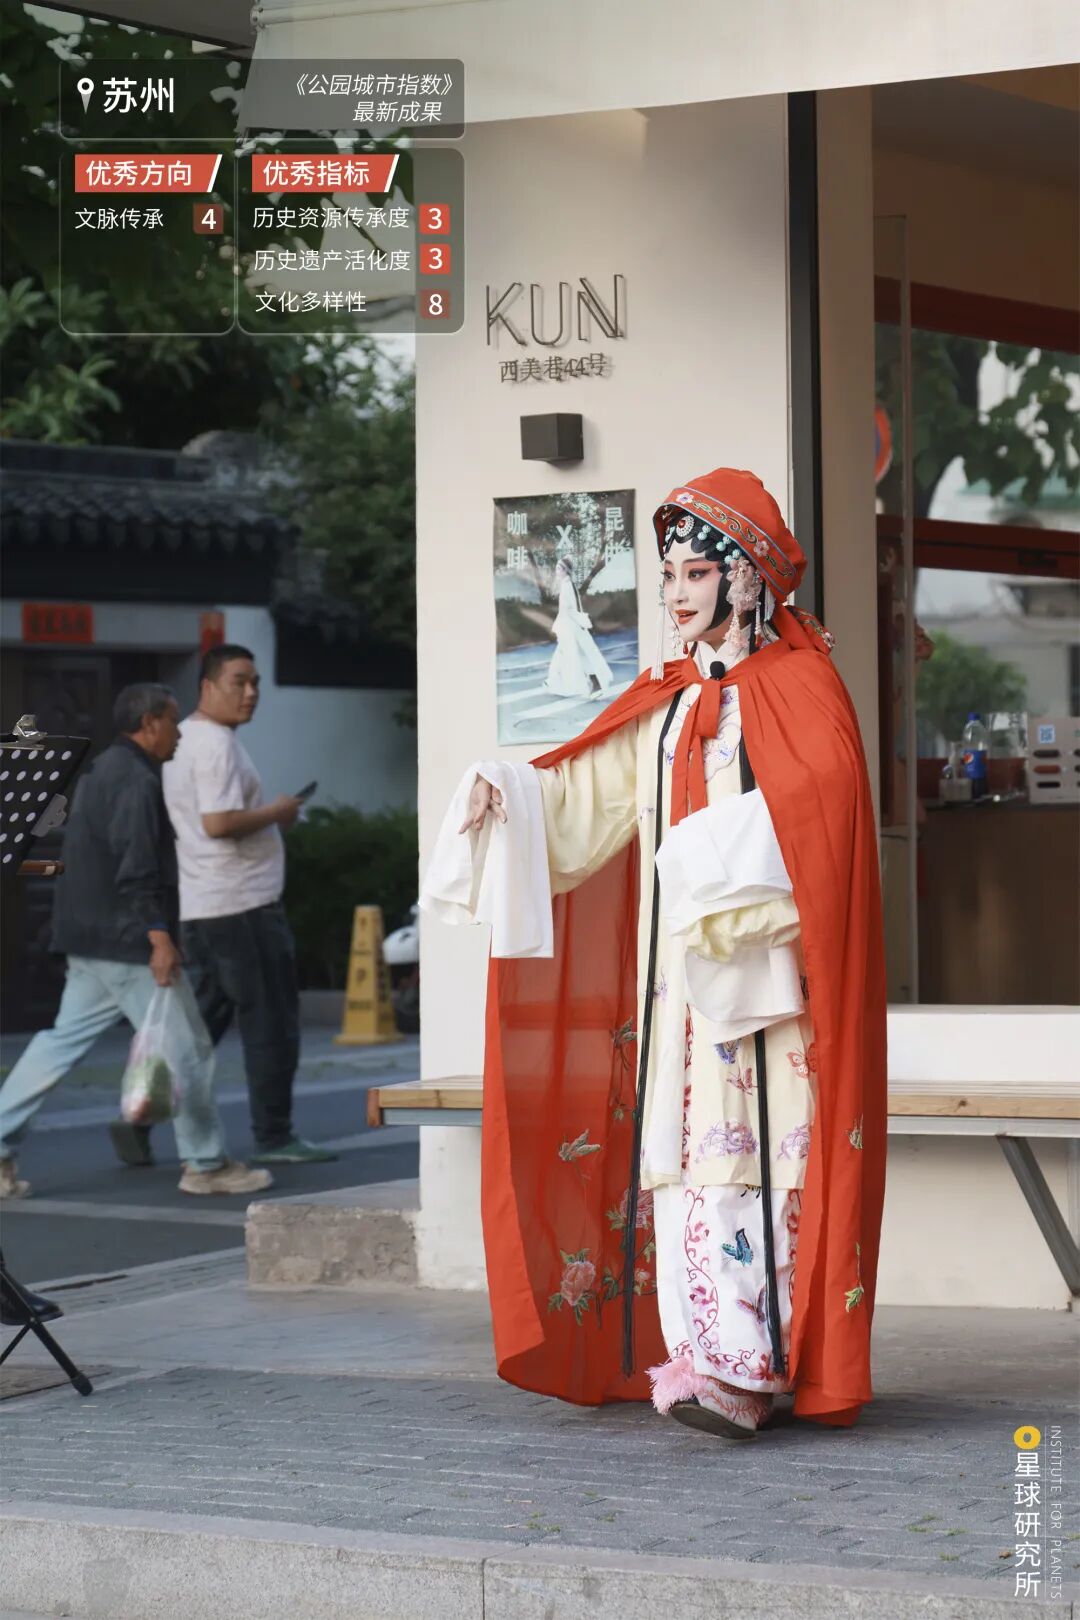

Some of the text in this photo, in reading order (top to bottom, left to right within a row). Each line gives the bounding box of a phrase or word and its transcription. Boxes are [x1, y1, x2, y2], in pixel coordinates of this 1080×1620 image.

[486, 274, 625, 346] KUN
[499, 352, 608, 383] 西美巷44号
[507, 510, 528, 570] 咖啡
